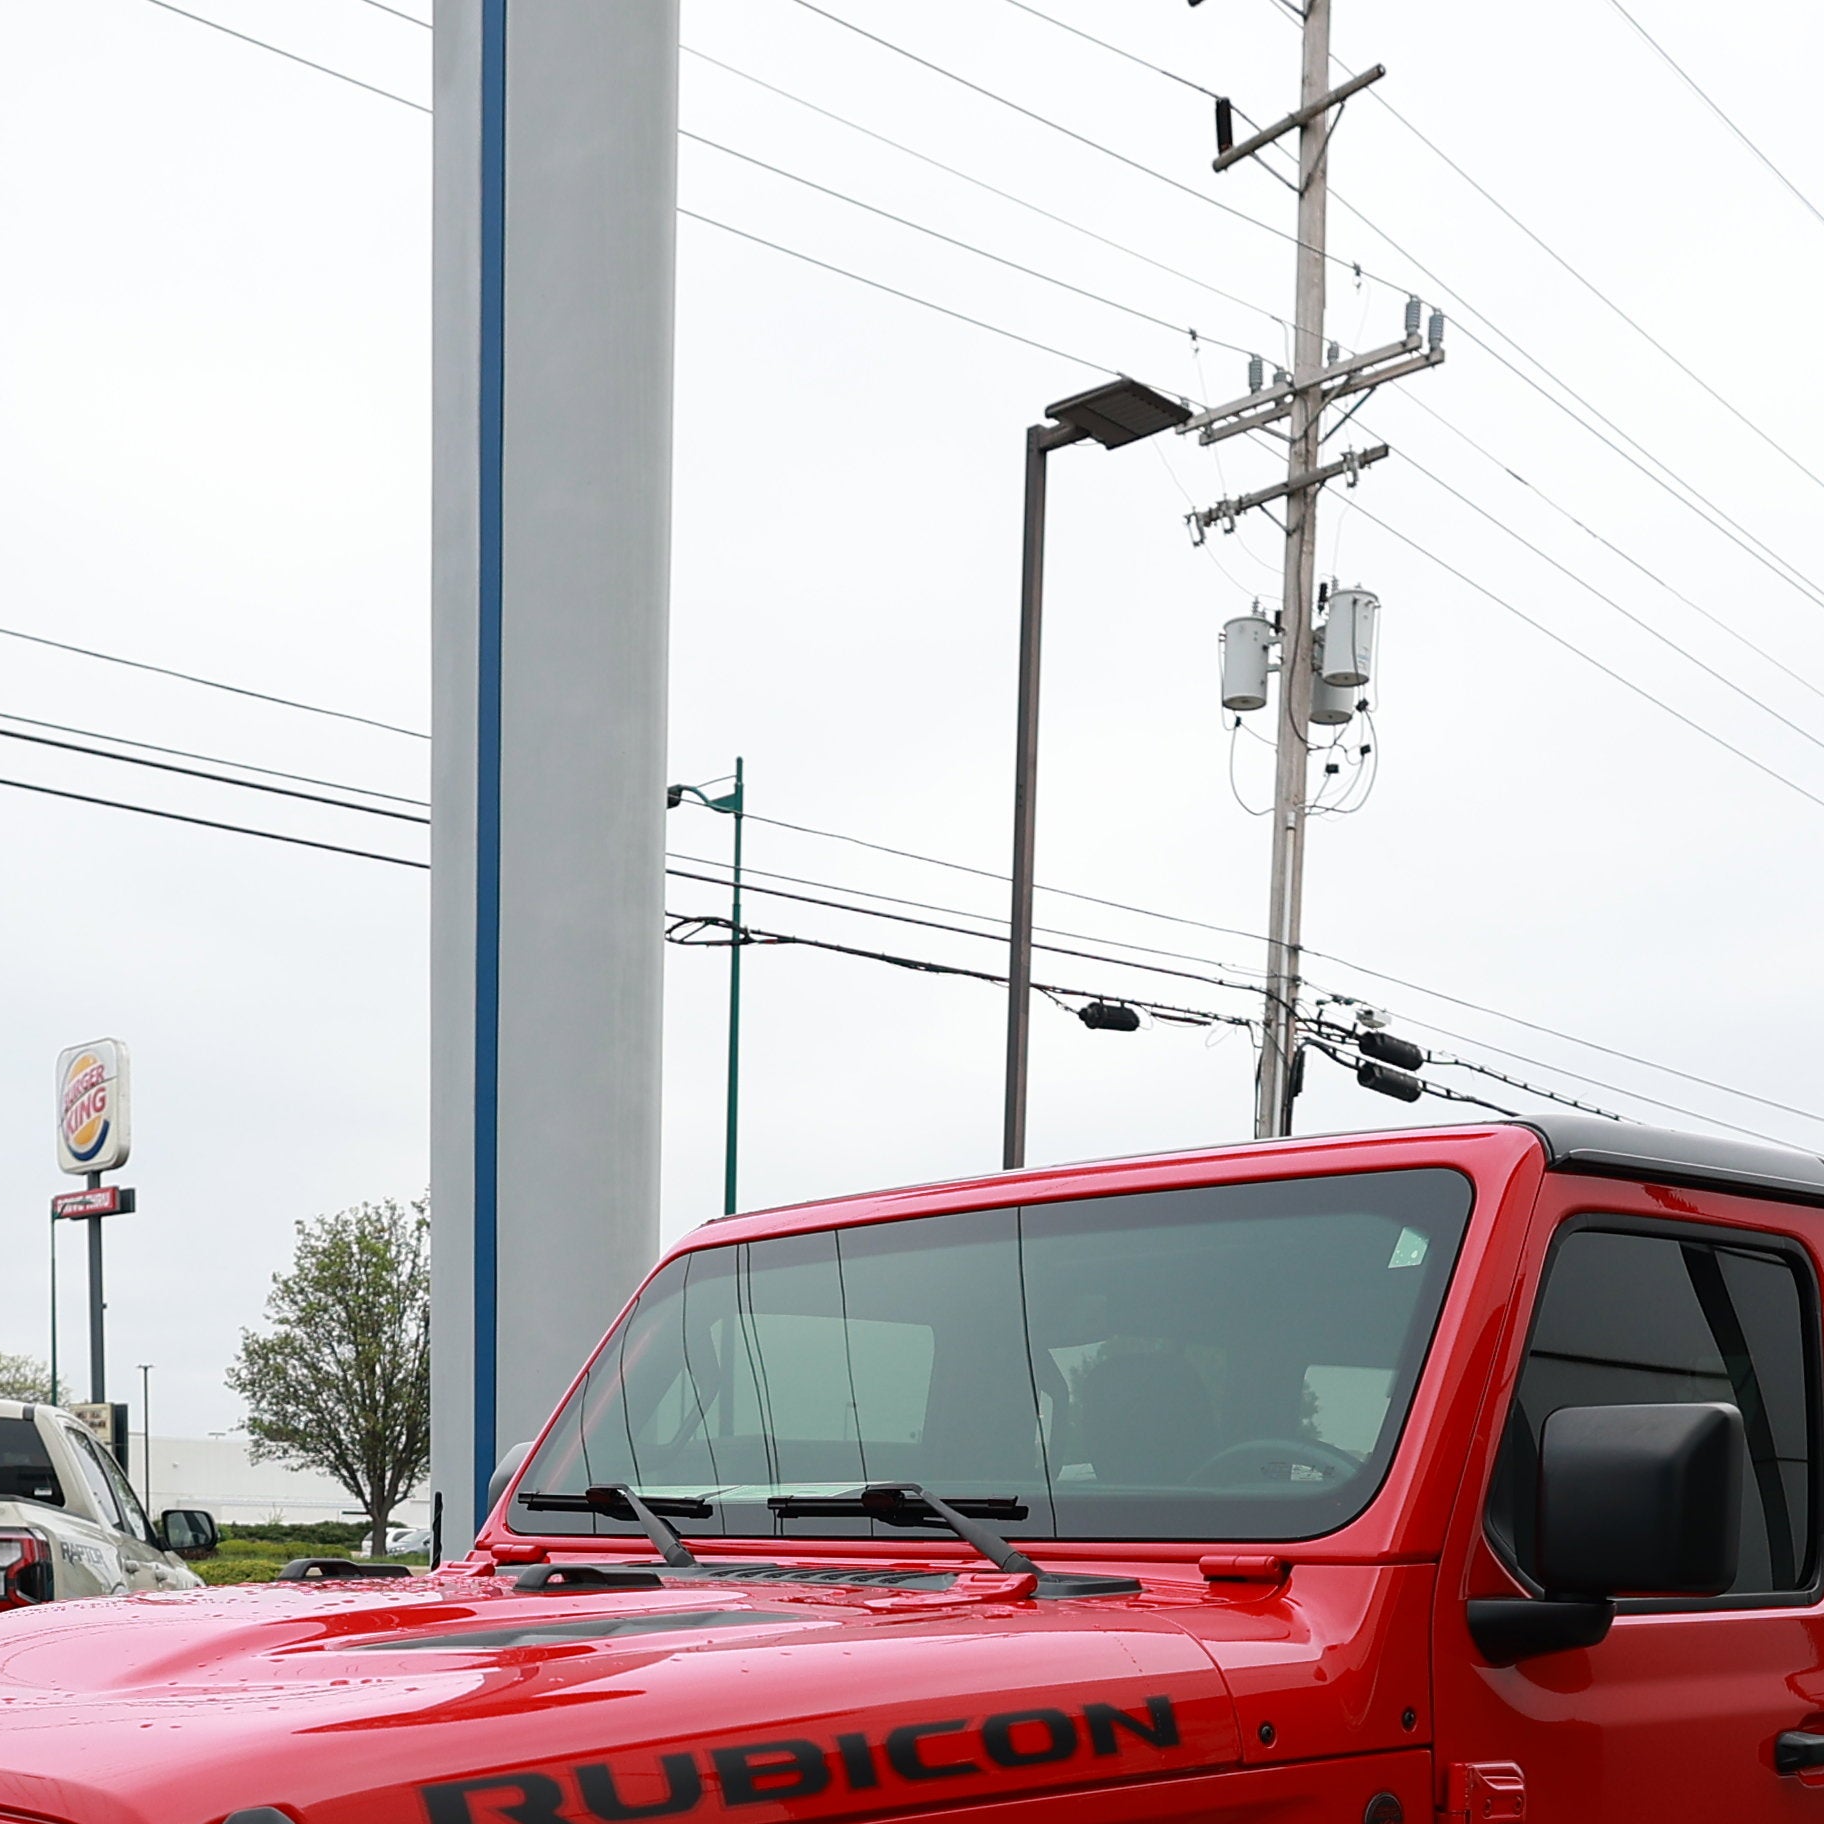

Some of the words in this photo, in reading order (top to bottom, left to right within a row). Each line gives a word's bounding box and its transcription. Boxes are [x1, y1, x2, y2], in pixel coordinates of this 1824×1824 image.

[63, 1064, 105, 1108] BURGER
[65, 1087, 107, 1134] KING
[60, 1541, 112, 1572] RAPTOR
